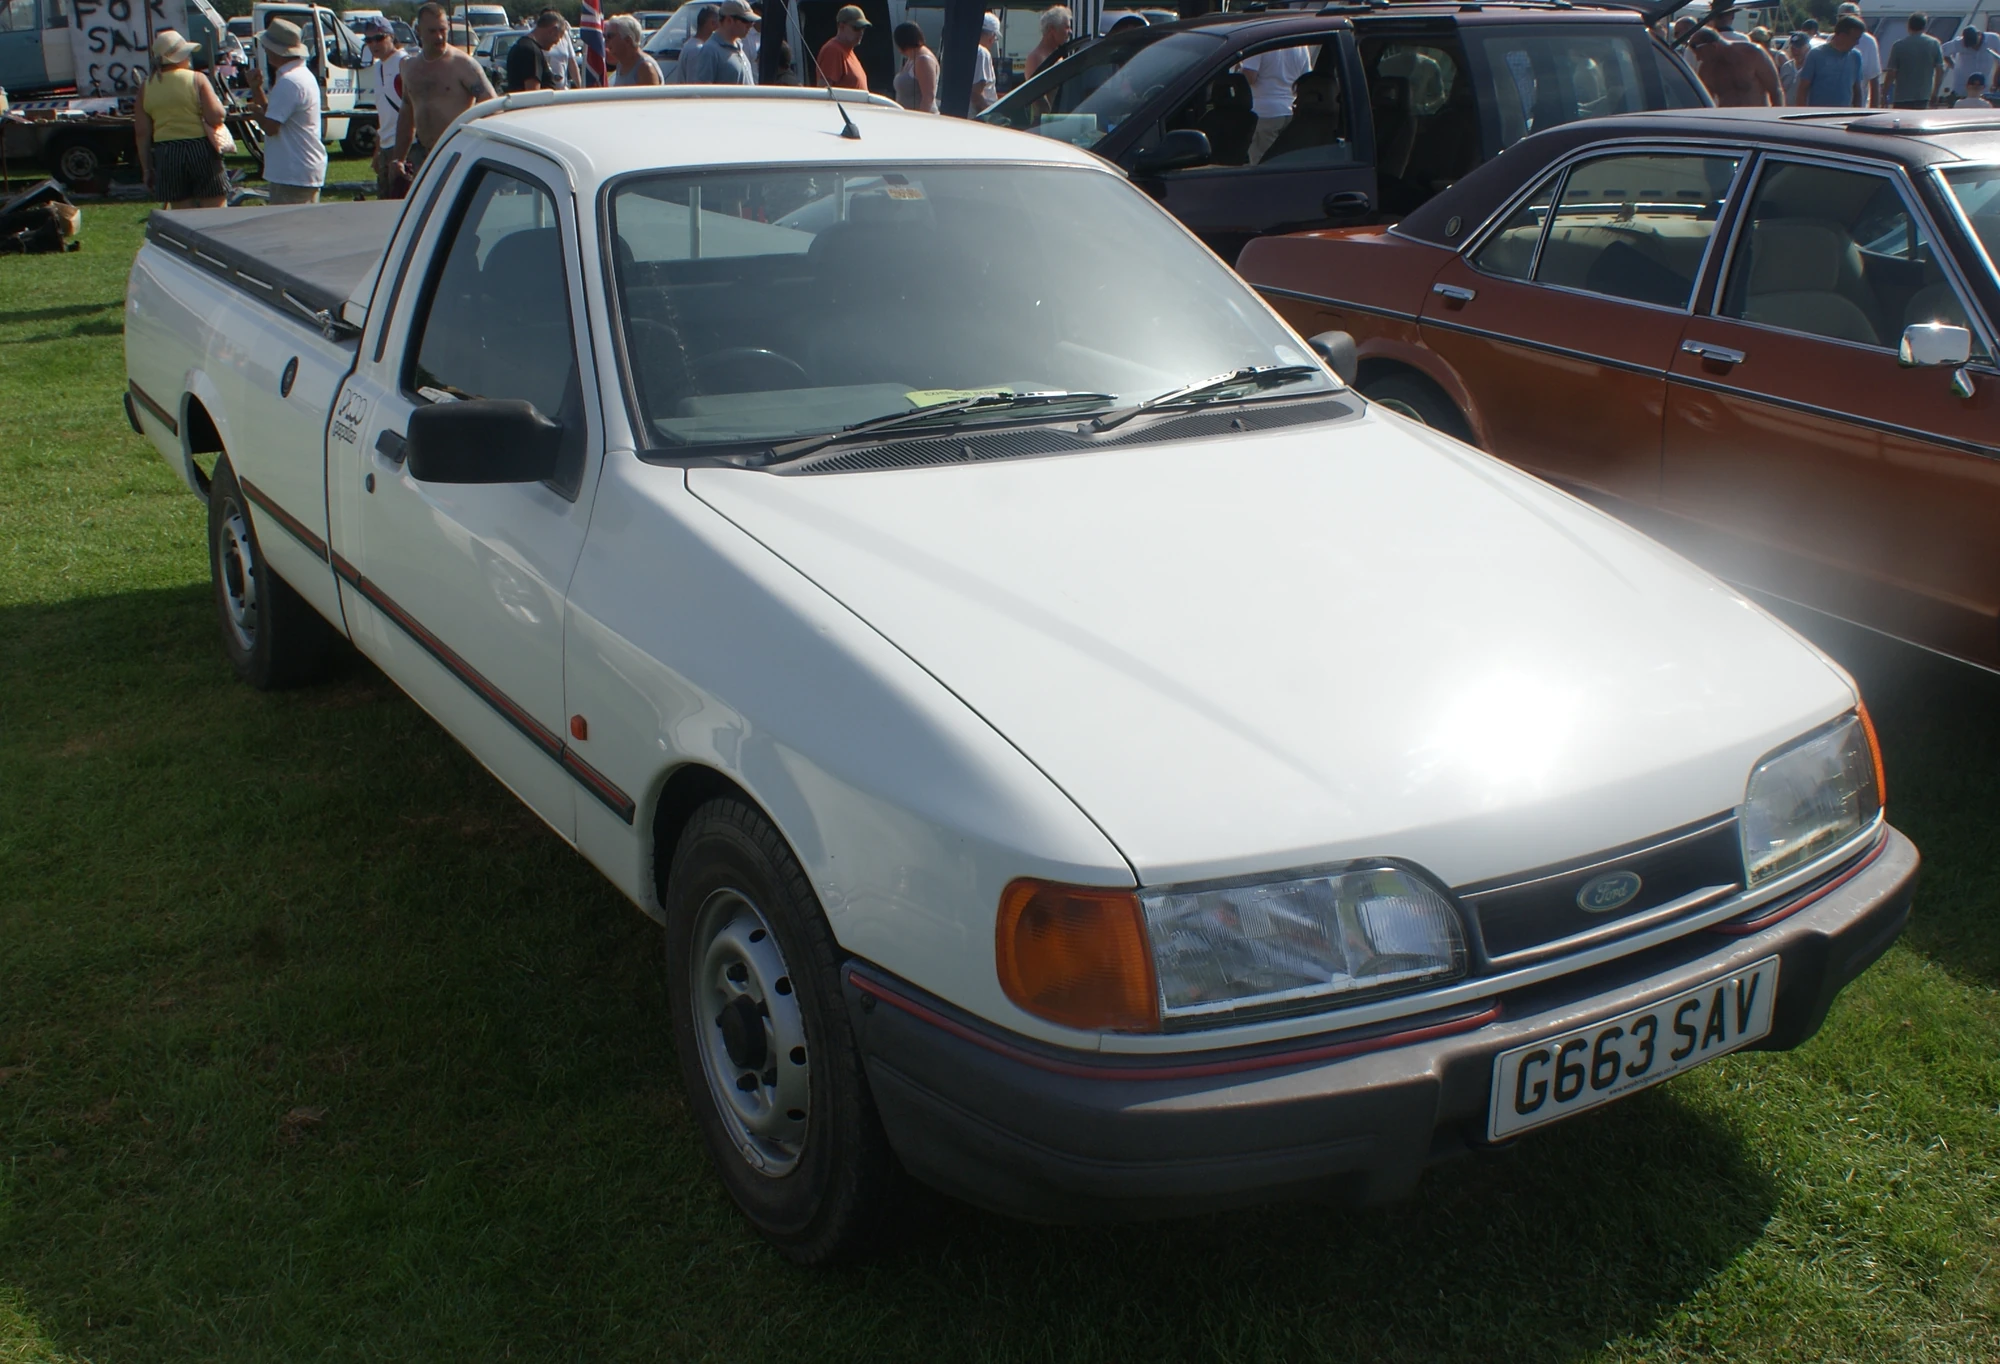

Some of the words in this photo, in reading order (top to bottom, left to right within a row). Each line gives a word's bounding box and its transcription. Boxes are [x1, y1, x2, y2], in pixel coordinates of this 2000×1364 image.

[72, 0, 166, 31] FOR
[88, 25, 175, 55] SAL
[1594, 879, 1628, 904] Ford
[1514, 1014, 1658, 1116] G663
[1670, 971, 1760, 1062] SAV
